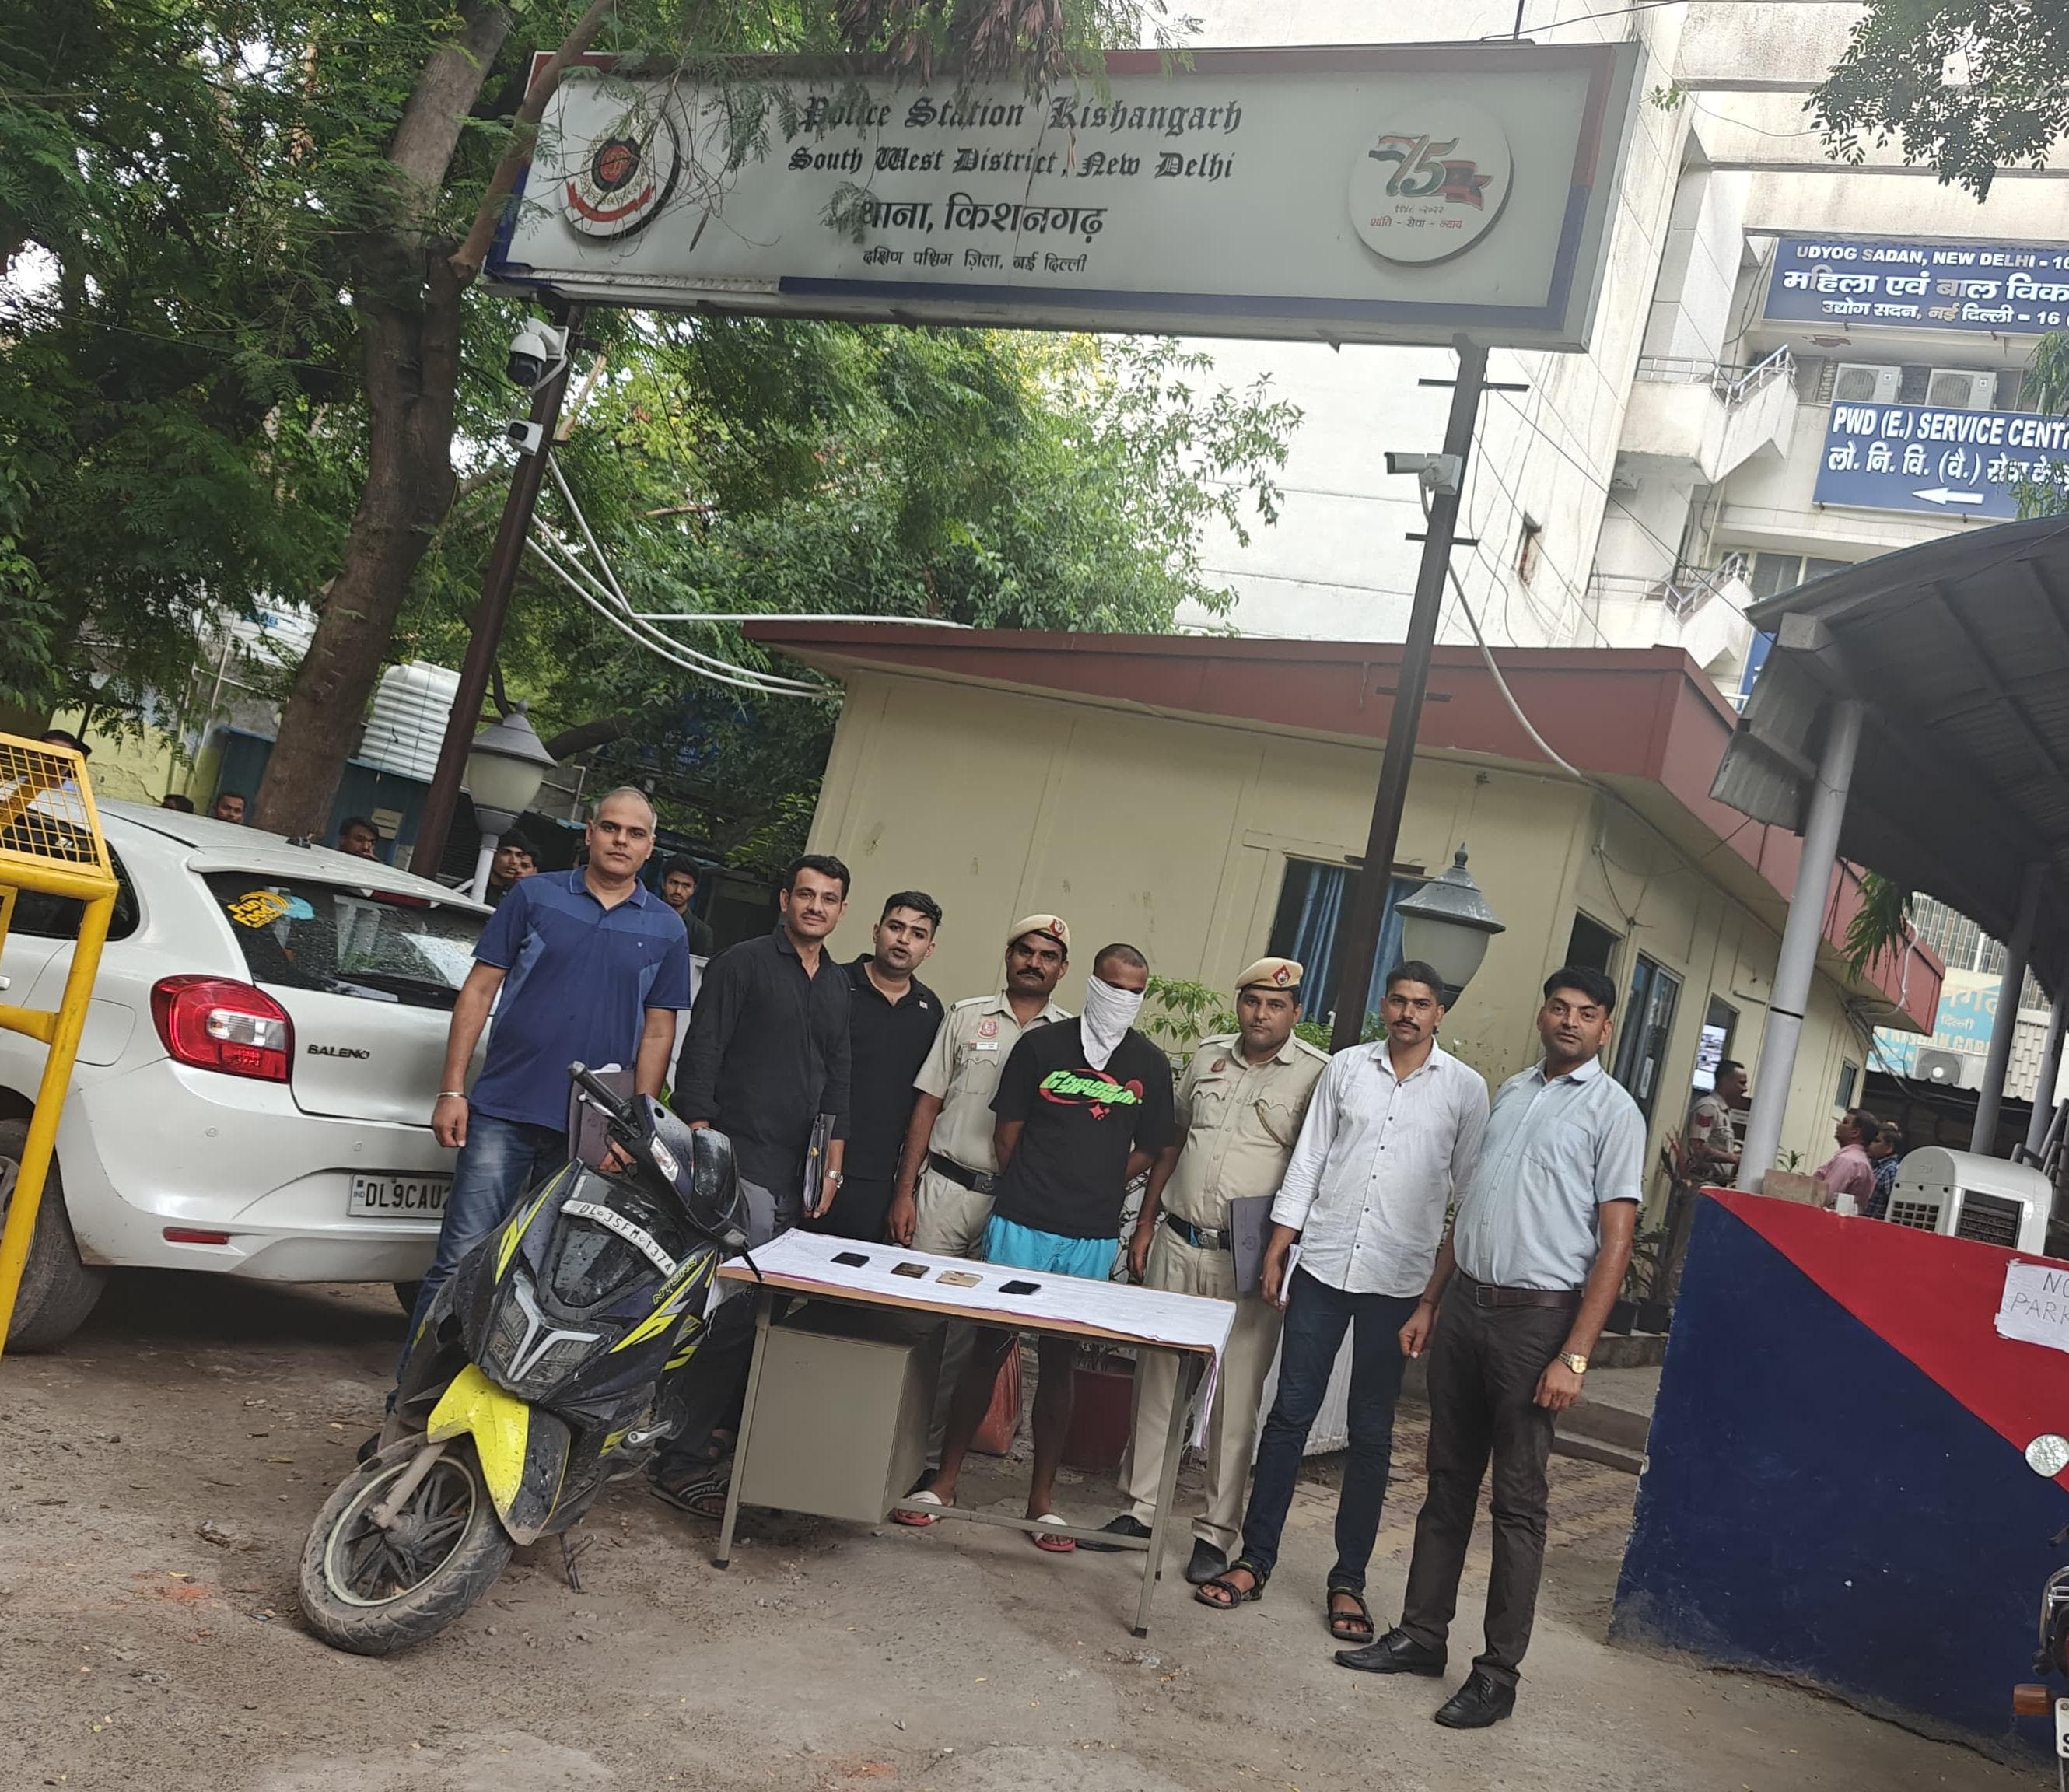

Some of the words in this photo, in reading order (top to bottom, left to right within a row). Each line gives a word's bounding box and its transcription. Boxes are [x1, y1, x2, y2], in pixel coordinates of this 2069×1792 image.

[904, 96, 1025, 128] Station
[1048, 96, 1242, 137] Kishangarh
[788, 146, 863, 174] South
[875, 145, 946, 173] West
[1076, 151, 1140, 178] New
[1154, 151, 1235, 182] Delhi
[944, 192, 1108, 244] किशनगढ़
[863, 246, 903, 265] दक्षिण
[1013, 251, 1038, 271] नई
[1044, 253, 1087, 273] दिल्ली
[1797, 246, 1857, 261] UDYOG
[1862, 248, 1928, 266] SADAN,
[1933, 251, 1976, 265] NEW
[1980, 253, 2036, 268] DELHI
[1783, 264, 1879, 293] महिला
[1885, 270, 1931, 296] एवं
[1936, 278, 2002, 299] बाल
[1822, 296, 1871, 316] उद्योग
[1928, 301, 1961, 322] नई
[1962, 302, 2015, 324] दिल्ली
[2037, 310, 2060, 325] 16
[1833, 406, 1877, 436] PWD
[1880, 410, 1914, 440] (E.)
[1917, 412, 2005, 446] SERVICE
[307, 1044, 370, 1059] BALENO
